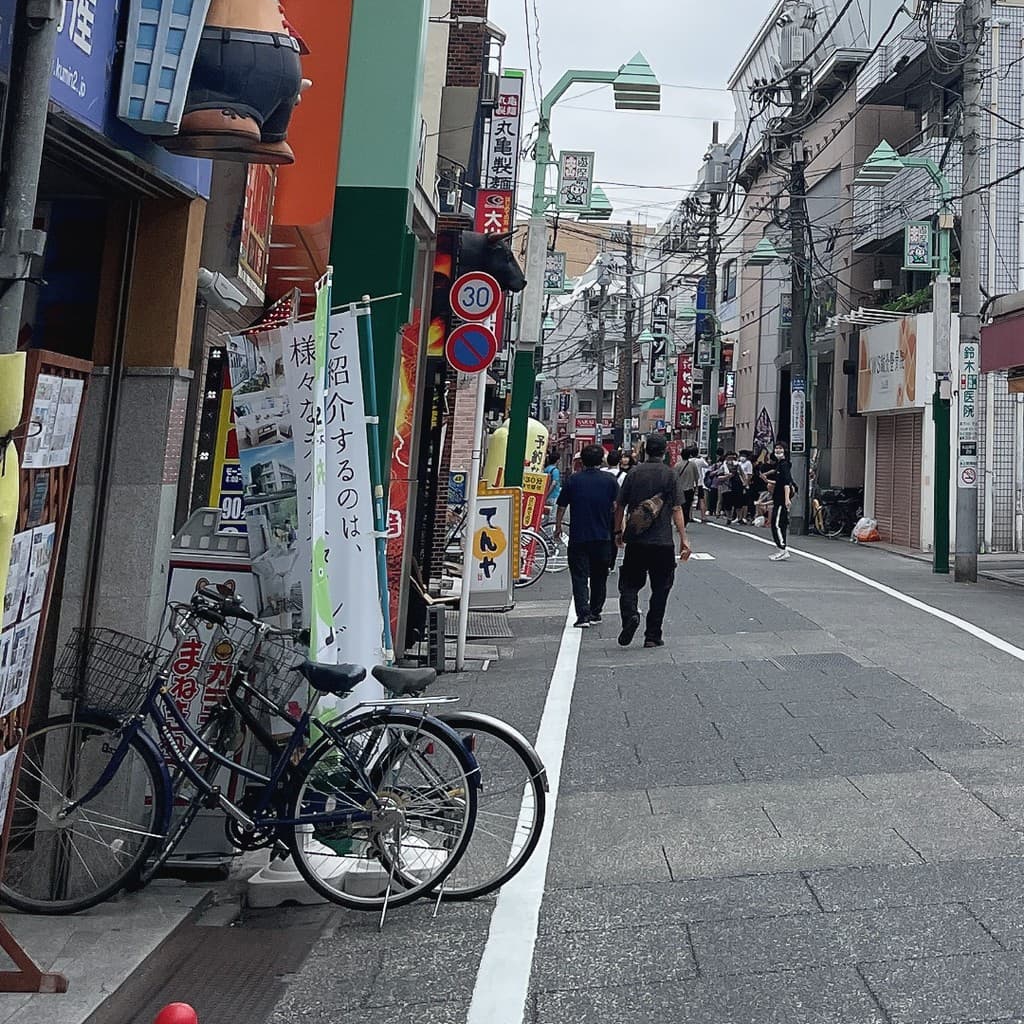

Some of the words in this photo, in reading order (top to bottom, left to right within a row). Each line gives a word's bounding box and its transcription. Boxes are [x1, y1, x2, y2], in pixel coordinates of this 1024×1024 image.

[485, 209, 503, 234] 大
[462, 285, 491, 308] 30
[478, 506, 498, 580] てんや
